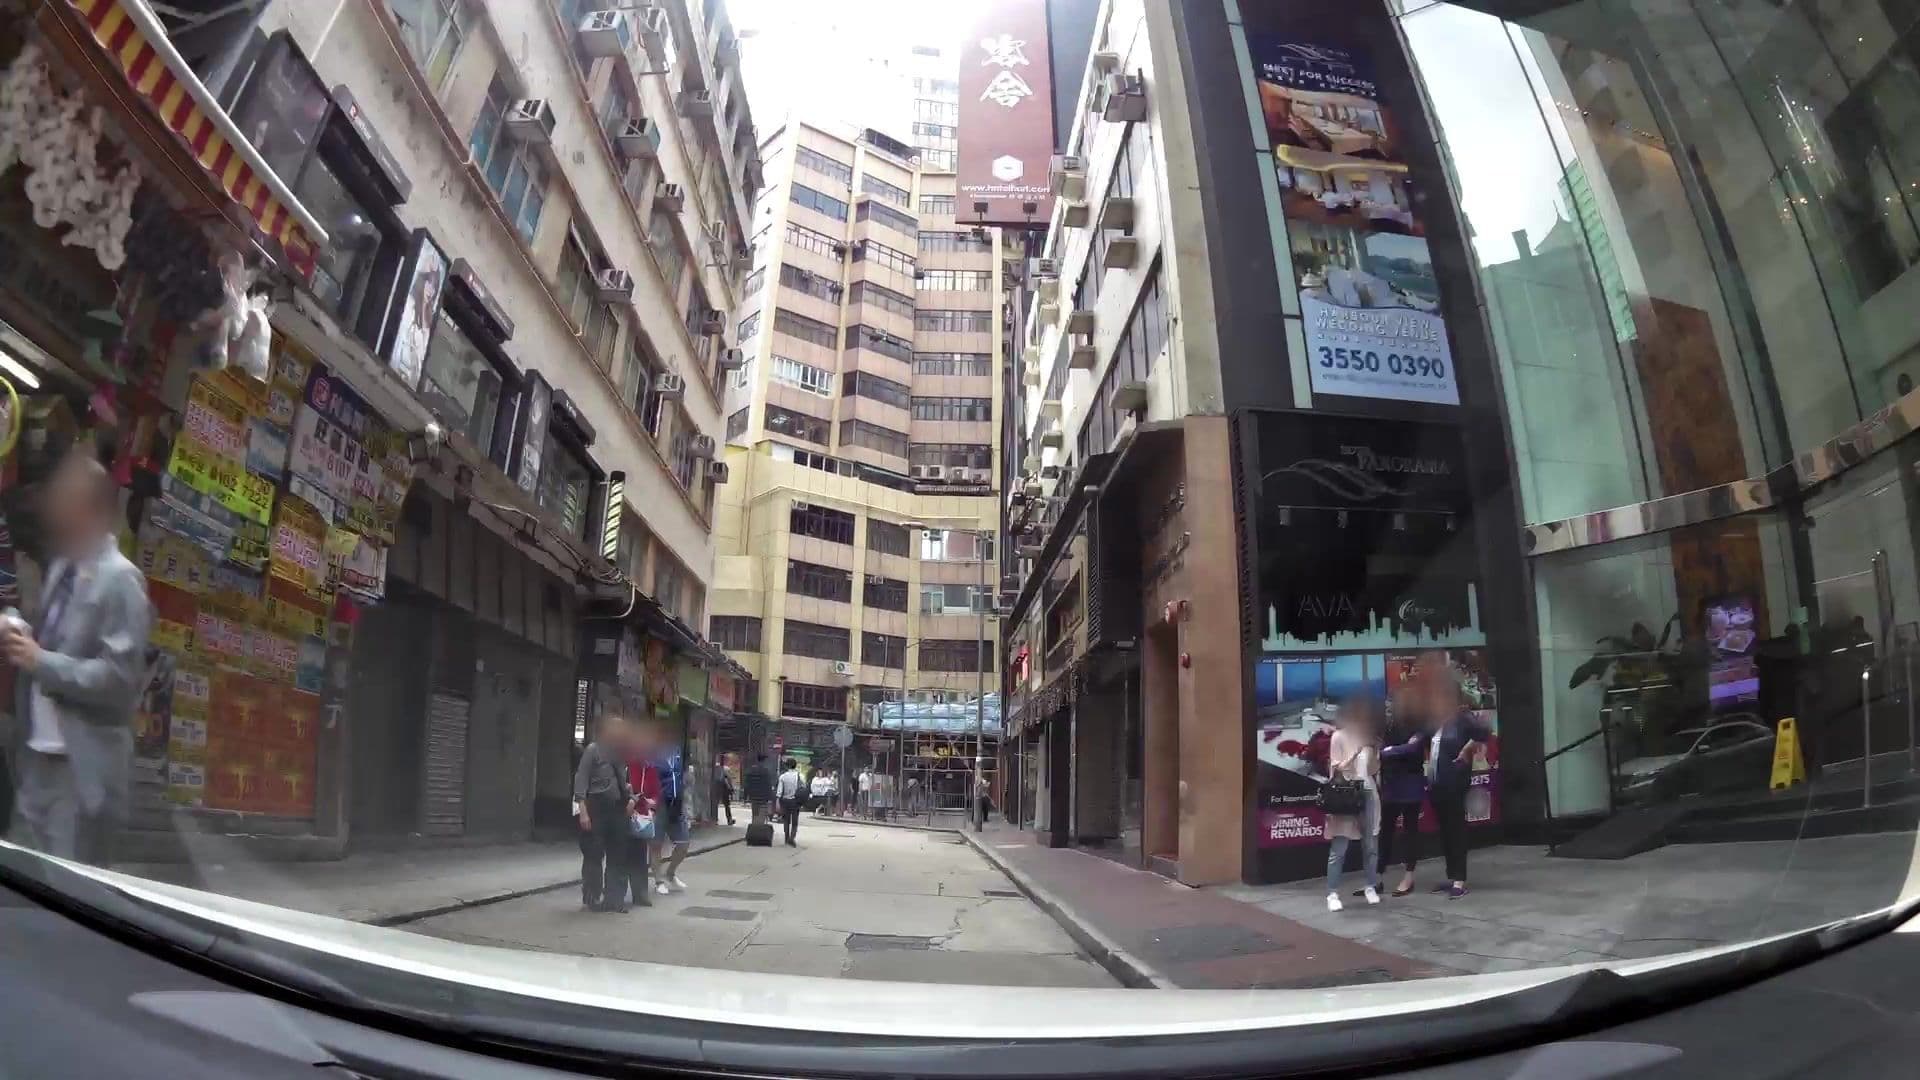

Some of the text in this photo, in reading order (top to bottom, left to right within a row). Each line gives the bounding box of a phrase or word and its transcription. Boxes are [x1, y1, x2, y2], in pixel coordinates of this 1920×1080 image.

[1318, 346, 1445, 379] 3550 0390
[1298, 592, 1355, 617] AVA
[1271, 826, 1323, 840] REWARDS
